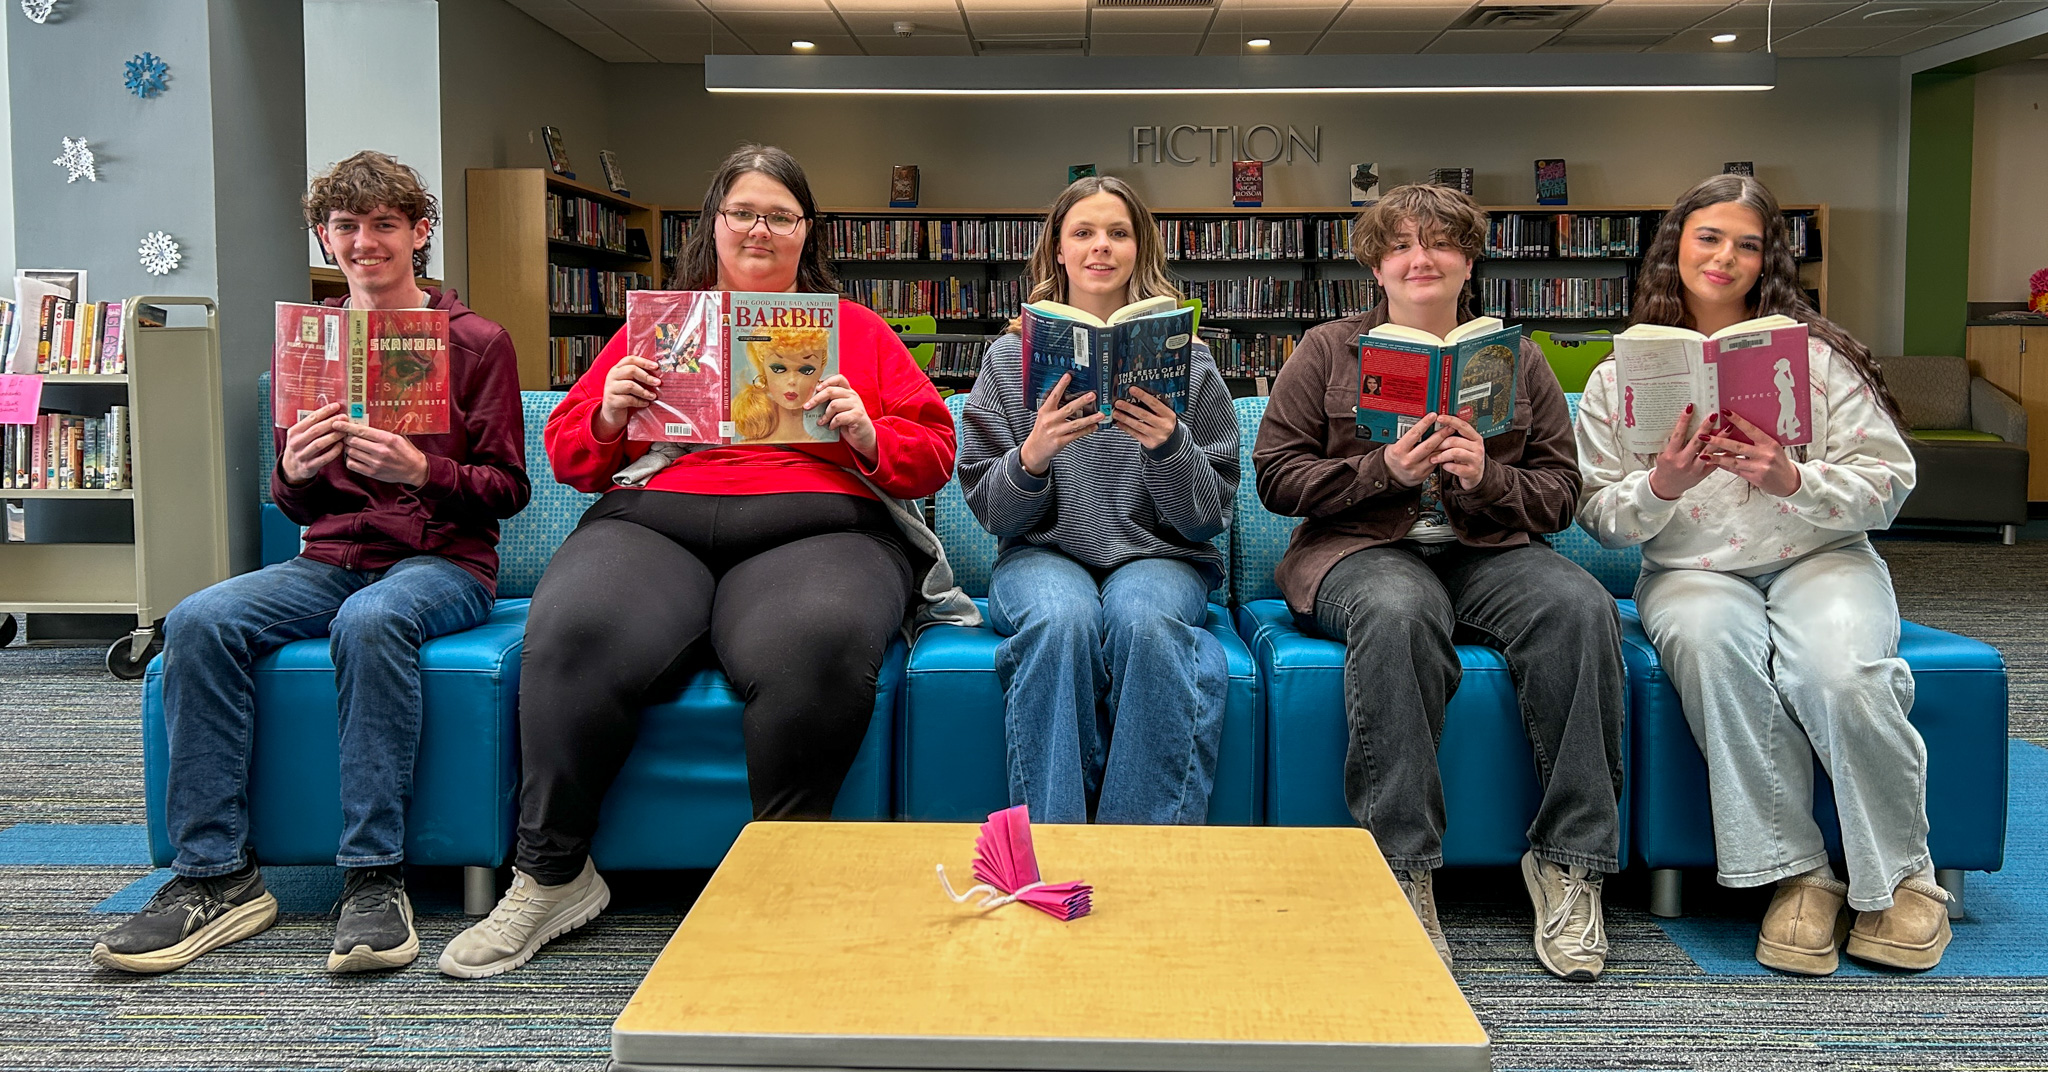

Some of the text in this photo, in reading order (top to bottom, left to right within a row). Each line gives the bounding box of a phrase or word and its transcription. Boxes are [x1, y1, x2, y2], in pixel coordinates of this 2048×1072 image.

[1132, 124, 1319, 163] FICTION
[55, 305, 63, 326] VOX
[734, 306, 833, 328] BARBIE
[403, 321, 442, 331] MIND
[370, 338, 446, 351] SKANDAL
[352, 347, 363, 403] SKANDA
[1102, 365, 1109, 373] OF
[1118, 363, 1186, 380] THE REST OF US
[1118, 369, 1185, 385] JUST LIVE HERE
[375, 382, 442, 392] IS MINE
[1164, 390, 1186, 399] NESS
[1730, 391, 1778, 402] PERFECT
[384, 413, 433, 424] ALONE
[1487, 424, 1505, 434] MILLER
